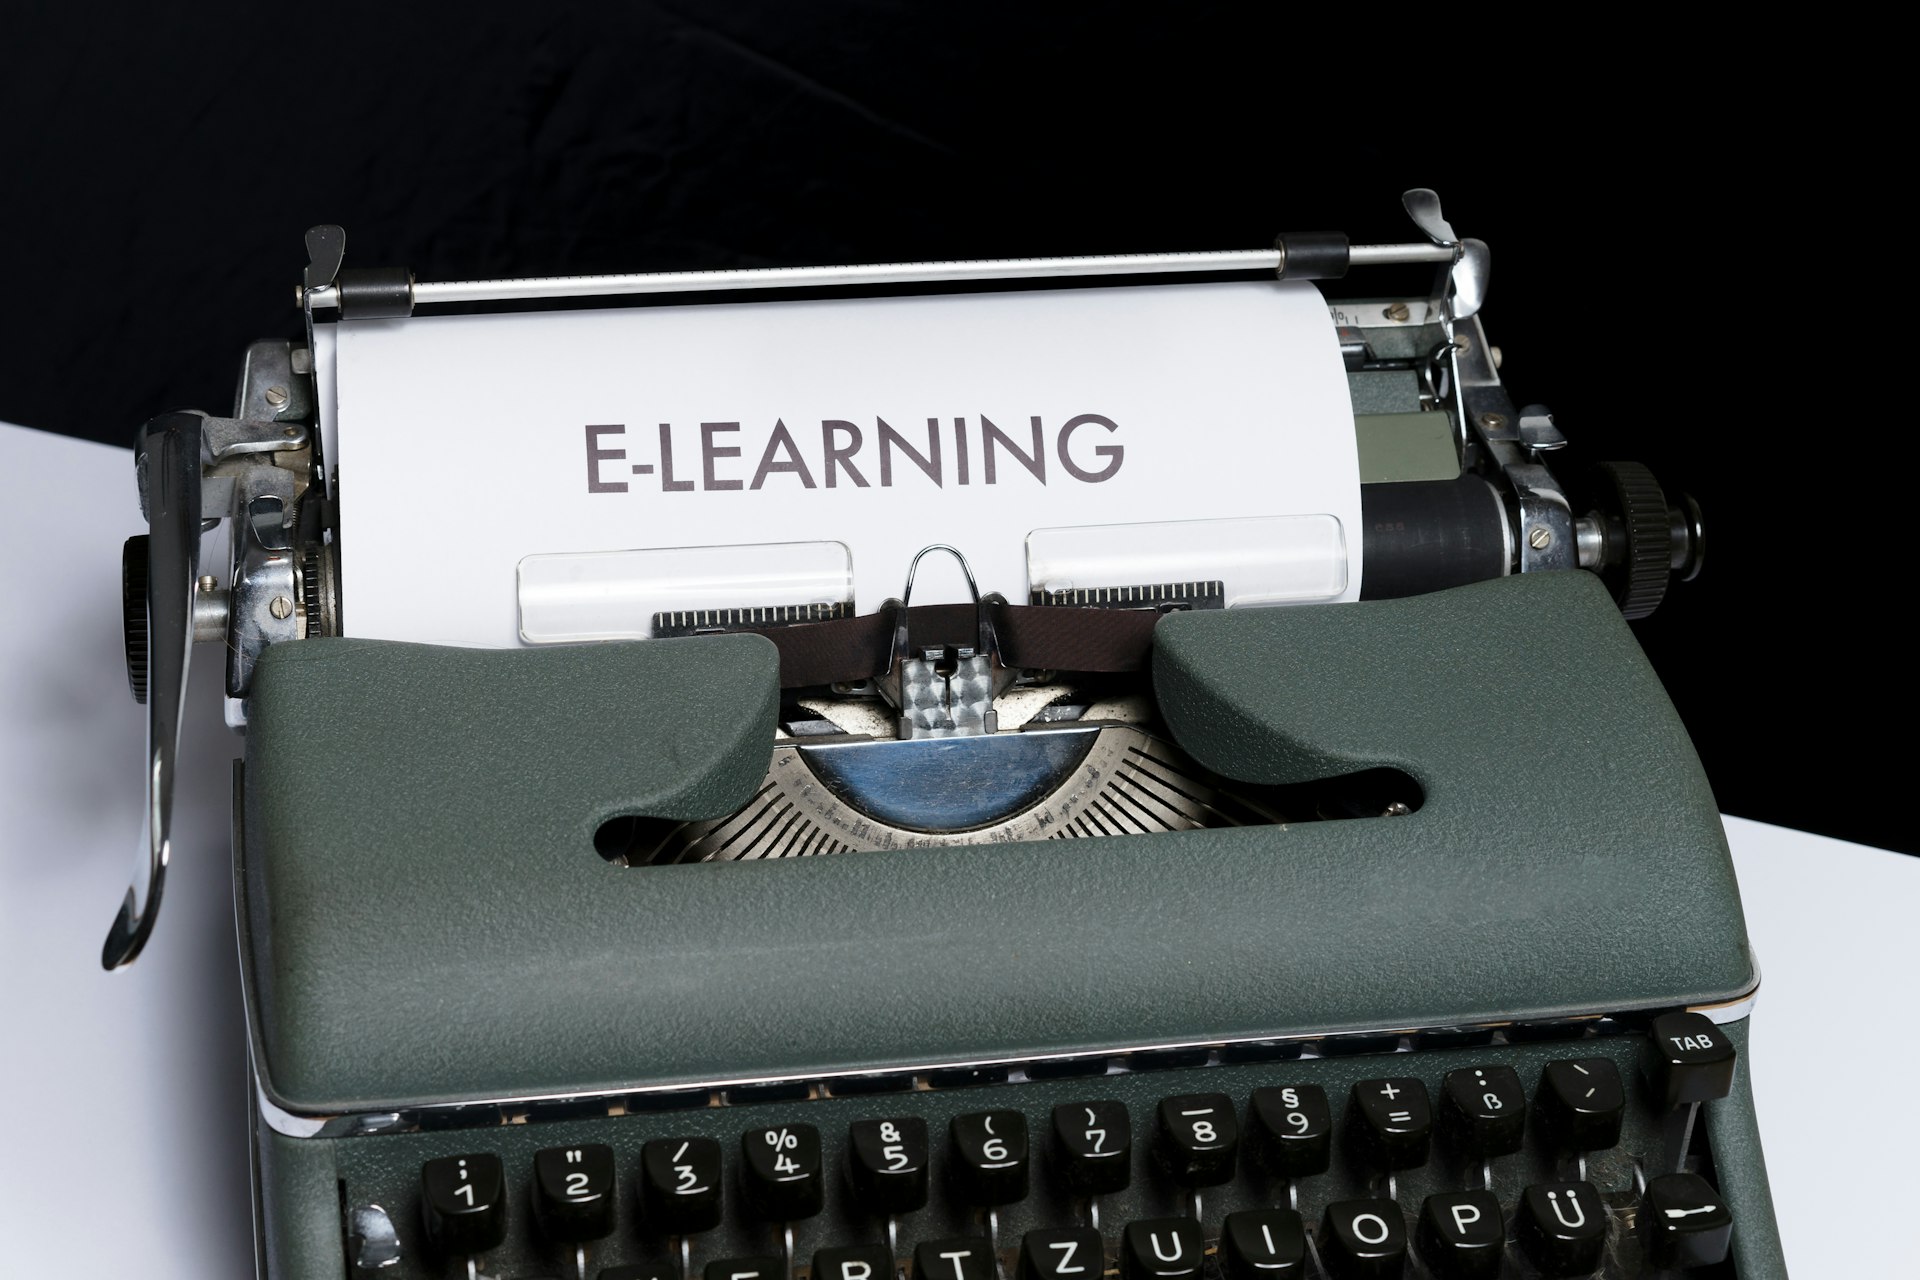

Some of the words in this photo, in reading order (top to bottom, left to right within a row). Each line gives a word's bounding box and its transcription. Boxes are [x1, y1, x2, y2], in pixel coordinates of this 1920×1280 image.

[585, 413, 1124, 493] E-LEARNING
[1669, 1033, 1714, 1052] TAB
[1281, 1087, 1300, 1109] §
[1380, 1083, 1401, 1100] +
[984, 1116, 995, 1135] (
[1085, 1107, 1096, 1126] )
[1286, 1112, 1309, 1134] 9
[1388, 1111, 1412, 1122] =
[765, 1128, 798, 1153] %
[879, 1121, 901, 1143] &
[1086, 1129, 1106, 1153] 7
[1192, 1120, 1217, 1143] 8
[883, 1145, 909, 1170] 5
[982, 1138, 1008, 1161] 6
[774, 1153, 801, 1174] 4
[565, 1172, 589, 1196] 2
[674, 1165, 698, 1192] 3
[454, 1184, 474, 1206] 1
[1451, 1204, 1481, 1235] P
[1547, 1189, 1585, 1228] Ü
[1262, 1224, 1276, 1255] I
[1352, 1213, 1389, 1244] O
[1049, 1241, 1085, 1274] Z
[1150, 1231, 1183, 1262] U
[939, 1250, 971, 1280] T
